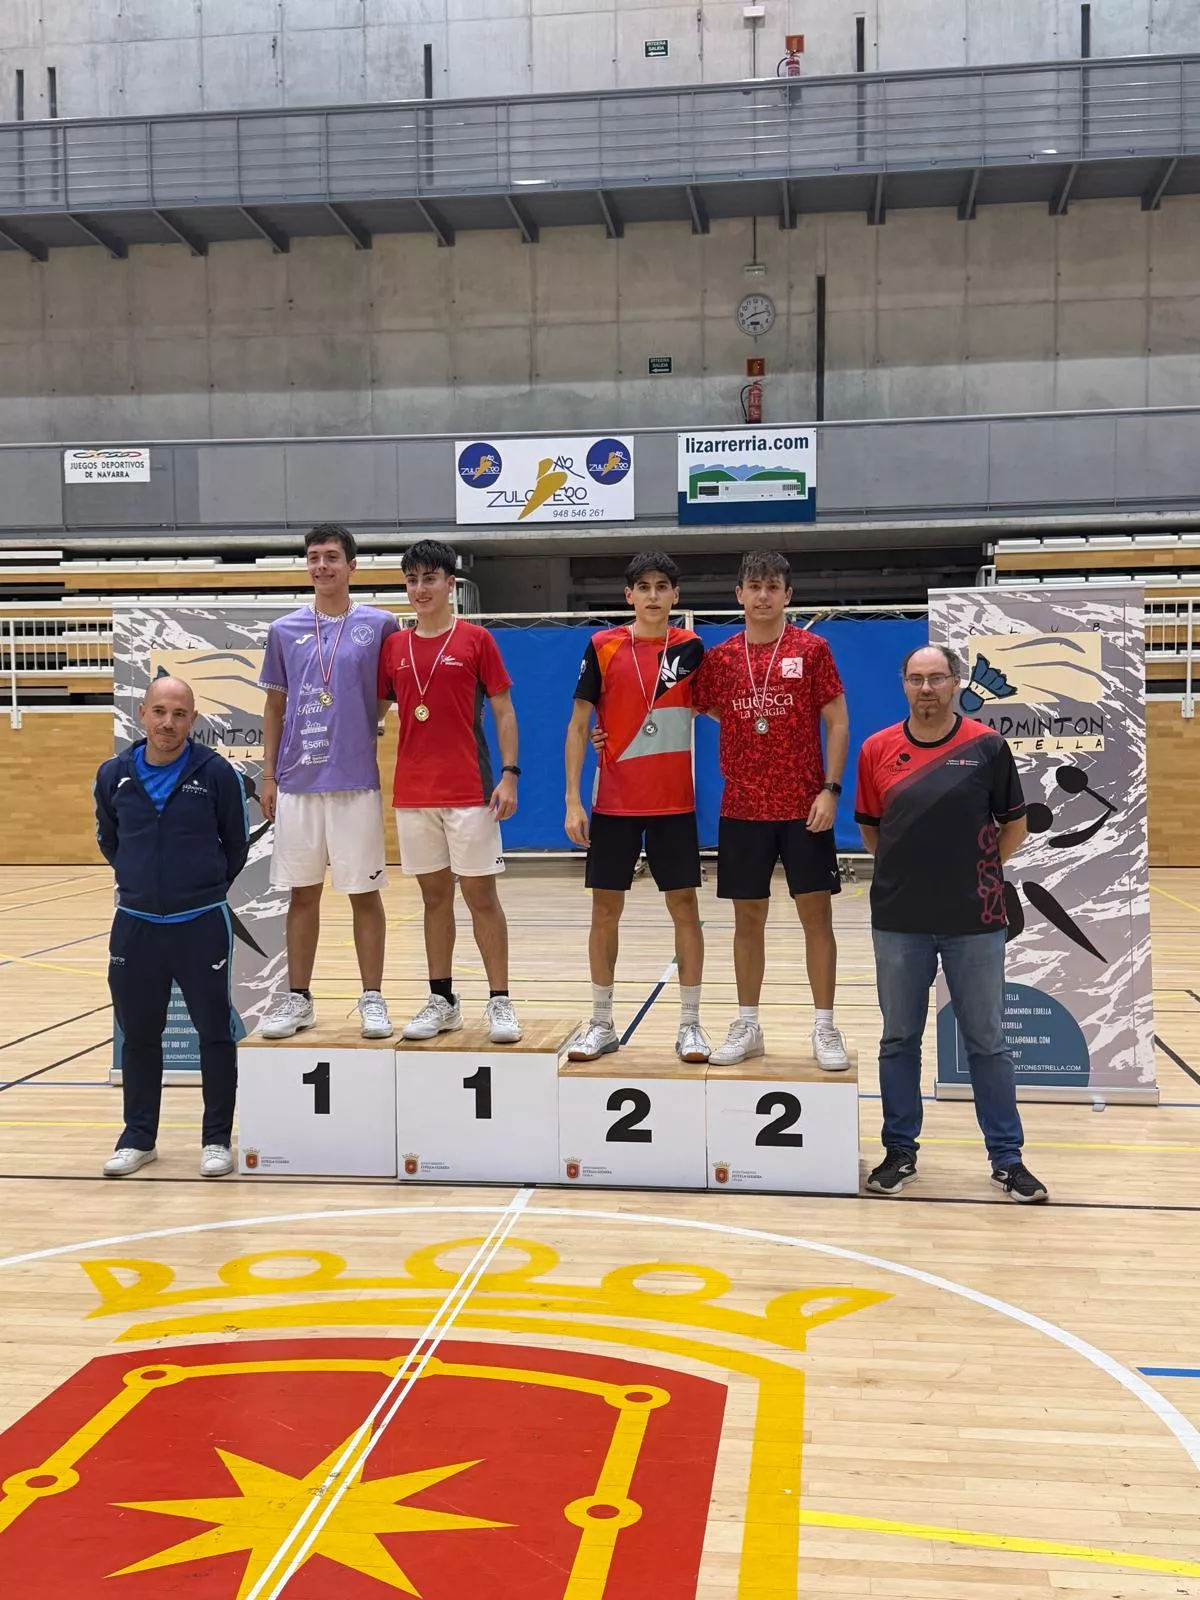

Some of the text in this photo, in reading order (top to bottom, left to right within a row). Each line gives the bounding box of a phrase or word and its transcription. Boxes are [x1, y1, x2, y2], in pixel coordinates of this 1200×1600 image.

[685, 434, 809, 454] lizarrerria.com
[70, 461, 145, 470] JUEGOS DEPORTIVOS
[552, 508, 605, 518] 948 546 261
[975, 716, 1104, 738] ADMINTON
[1013, 739, 1103, 750] TELLA
[302, 1061, 331, 1115] 1
[463, 1066, 492, 1119] 1
[605, 1087, 653, 1143] 2
[755, 1091, 804, 1147] 2
